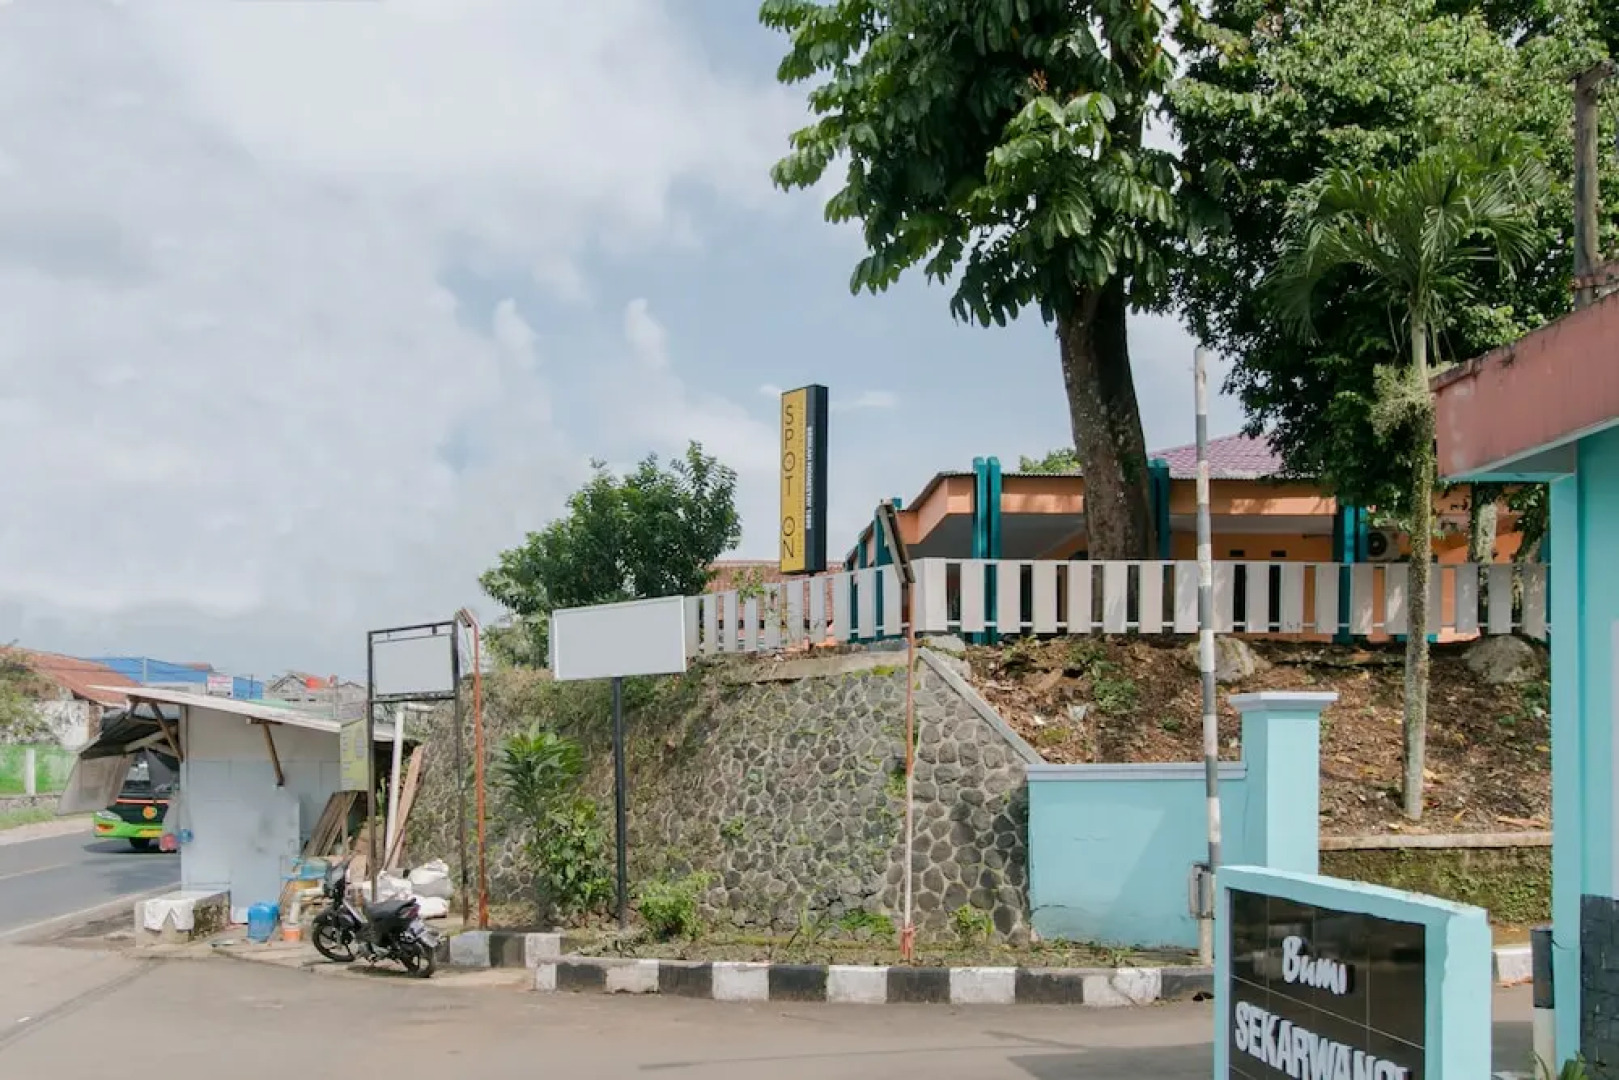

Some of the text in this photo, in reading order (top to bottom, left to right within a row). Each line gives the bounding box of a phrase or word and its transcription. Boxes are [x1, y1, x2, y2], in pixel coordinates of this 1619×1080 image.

[783, 404, 795, 559] SPOT ON
[1235, 1001, 1409, 1080] SEKARWAN
